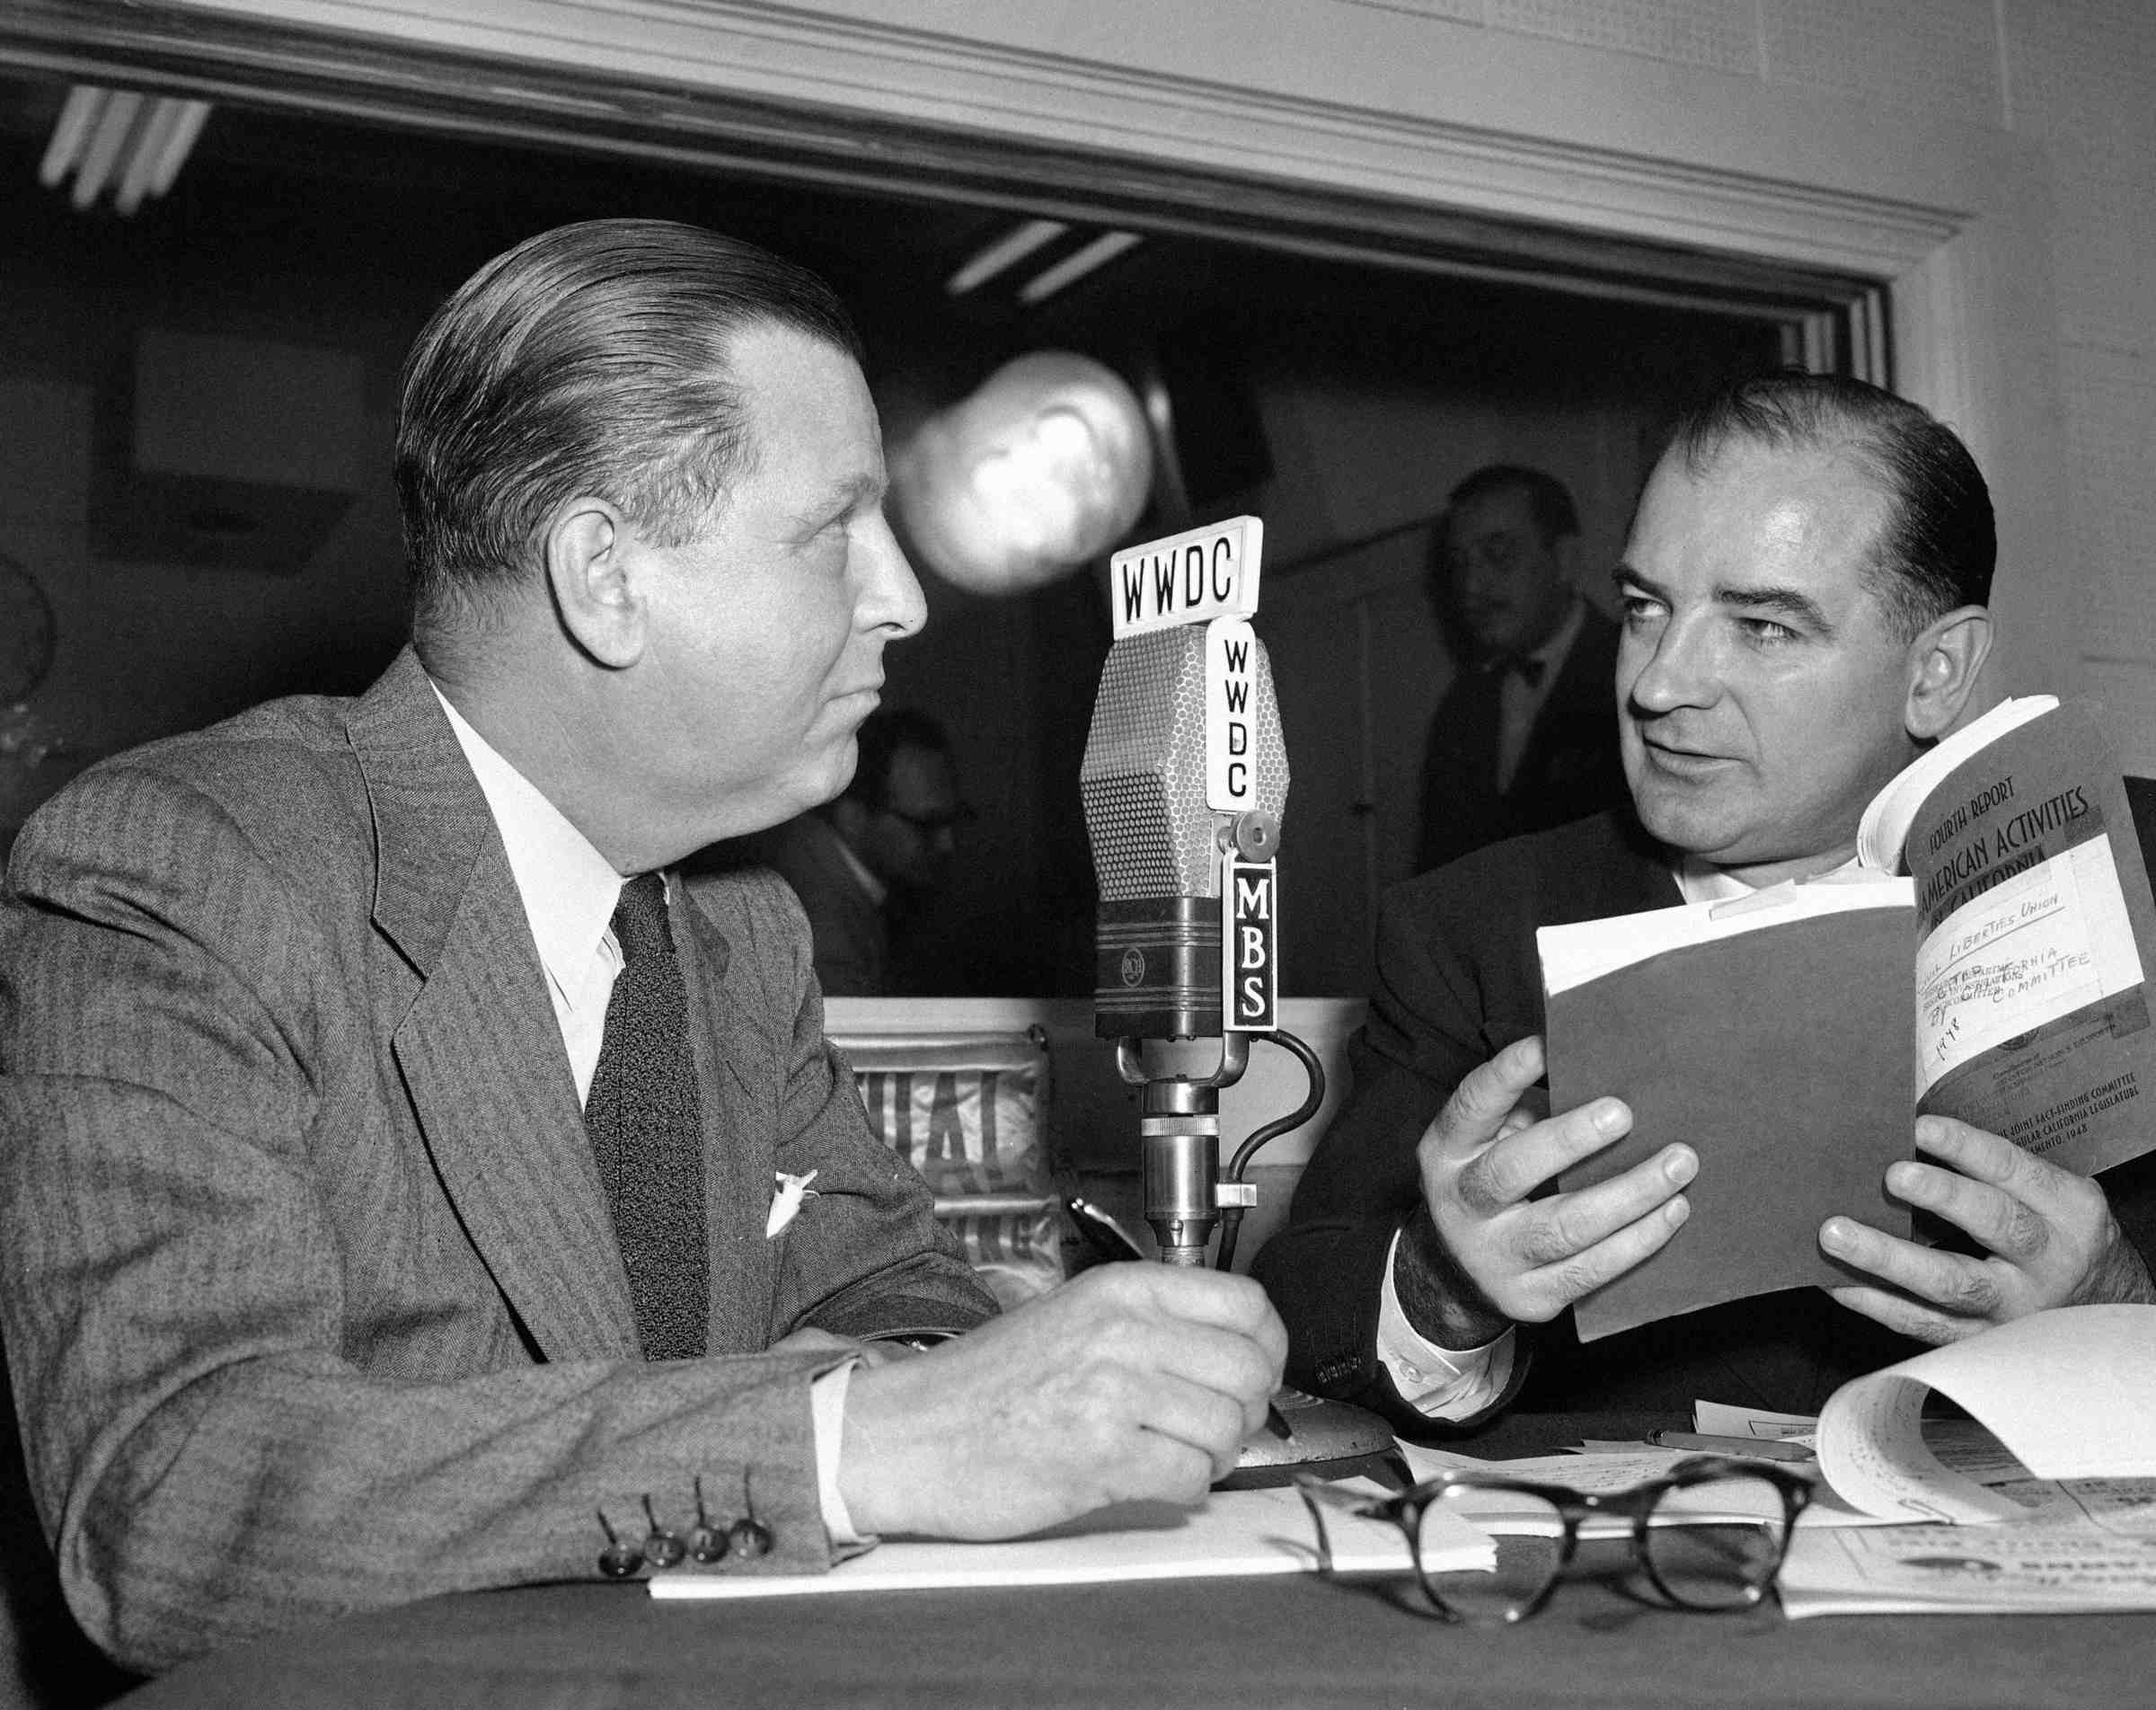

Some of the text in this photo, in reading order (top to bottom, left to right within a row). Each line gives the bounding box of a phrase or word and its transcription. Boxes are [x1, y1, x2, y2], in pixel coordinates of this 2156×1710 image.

[1122, 536, 1233, 625] WWDC
[1224, 639, 1250, 798] WWDC
[1930, 775, 2015, 855] FOURTH REPORT
[1997, 785, 2090, 858] ACTIVITIES
[1235, 878, 1269, 1018] MBS
[1948, 914, 2016, 961] LIBERTIES
[1935, 1017, 1960, 1060] 1948
[2043, 1106, 2088, 1135] CALIFORNIA
[2089, 1085, 2140, 1116] LEGISLATURE
[2090, 1071, 2136, 1101] COMMITTEE
